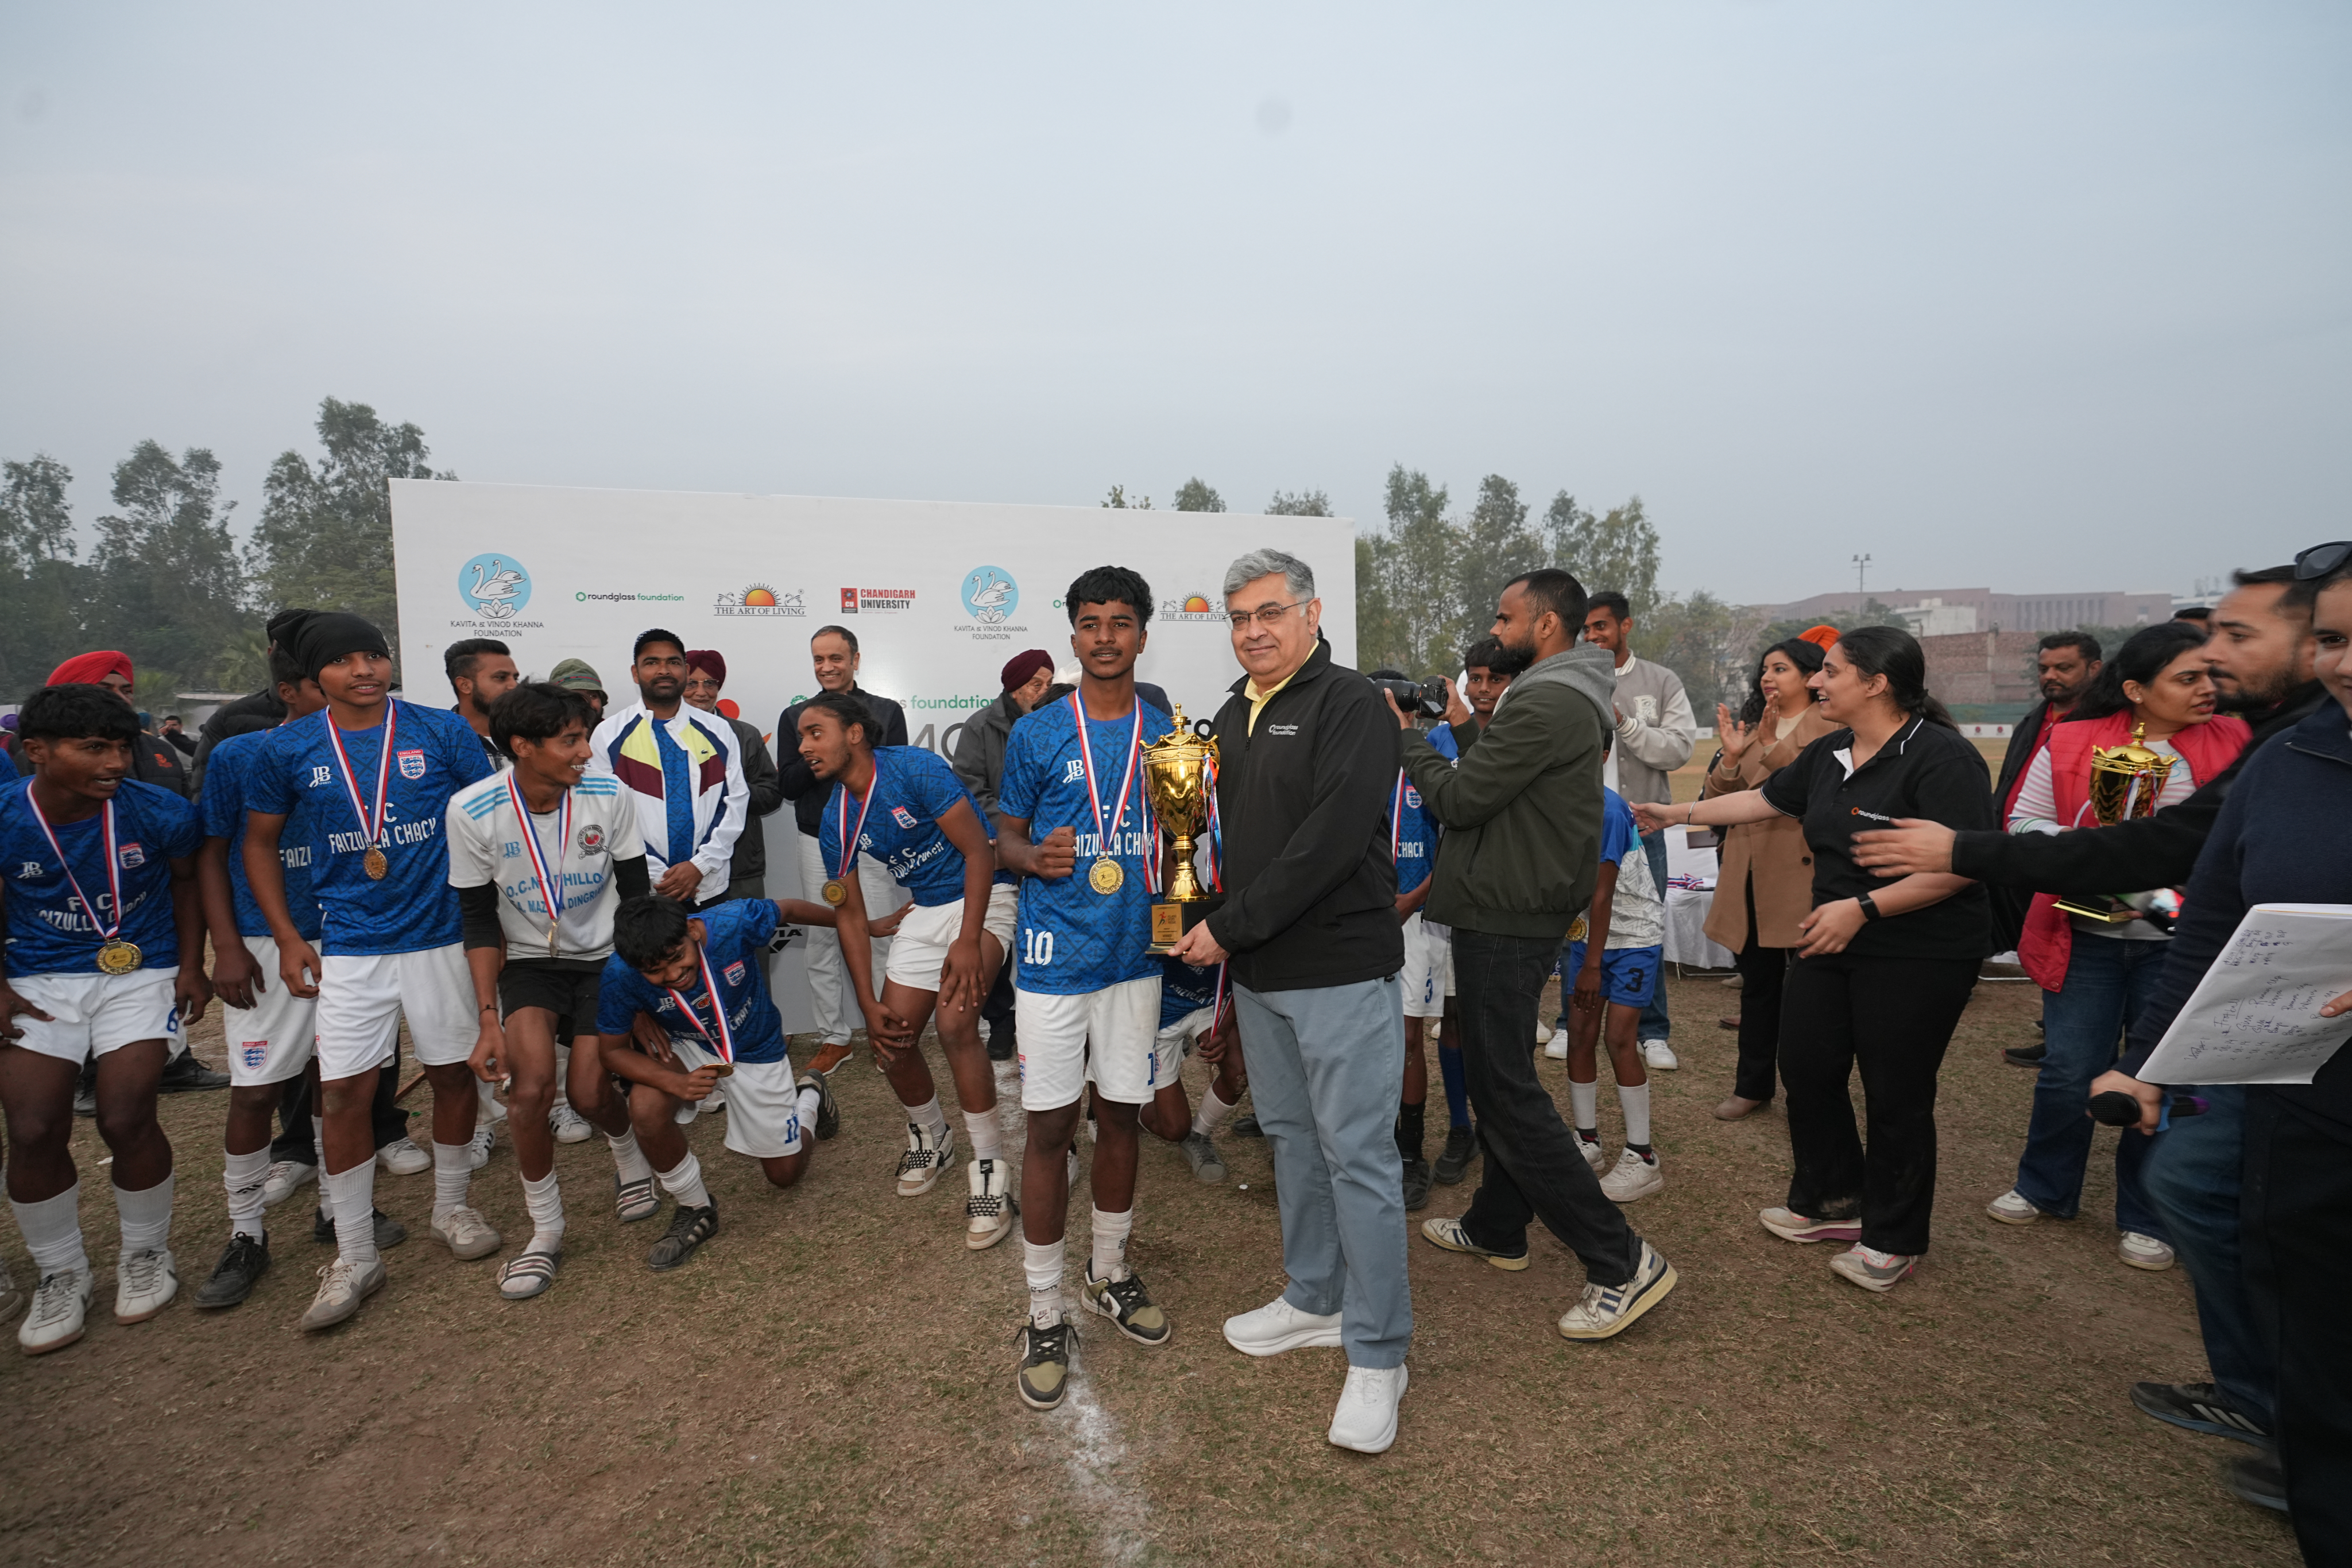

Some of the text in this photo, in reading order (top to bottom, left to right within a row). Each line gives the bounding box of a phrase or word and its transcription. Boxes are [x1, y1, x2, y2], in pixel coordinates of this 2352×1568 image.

[588, 593, 684, 602] roundglass foundation
[860, 589, 916, 598] CHANDIGARH
[861, 599, 910, 609] UNIVERSITY
[1858, 810, 1889, 820] roundglass
[1024, 928, 1054, 965] 10
[1625, 967, 1644, 993] 3
